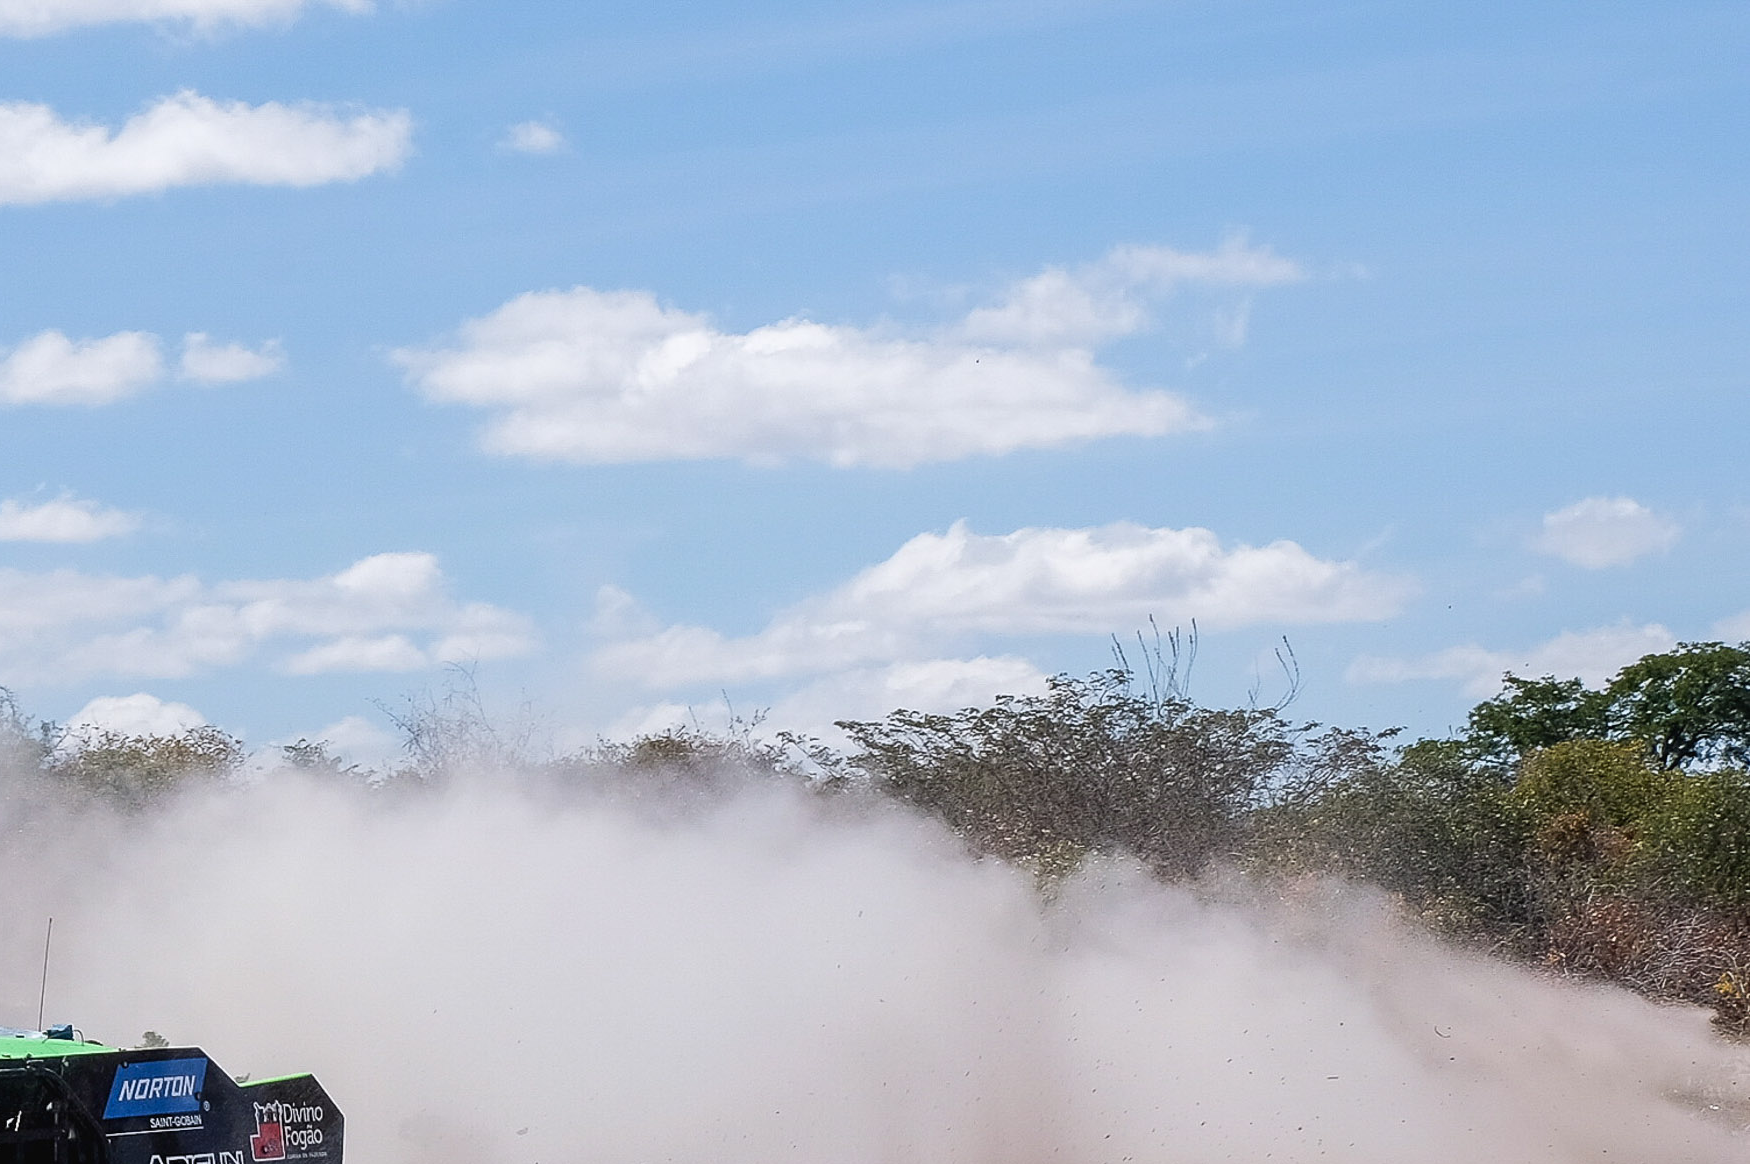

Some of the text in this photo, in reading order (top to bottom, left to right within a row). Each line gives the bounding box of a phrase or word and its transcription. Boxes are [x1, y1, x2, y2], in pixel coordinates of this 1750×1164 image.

[118, 1075, 196, 1102] NORTON
[150, 1114, 202, 1129] SAINT-GOBAIN
[282, 1101, 323, 1124] Divino
[284, 1124, 323, 1150] Fogão
